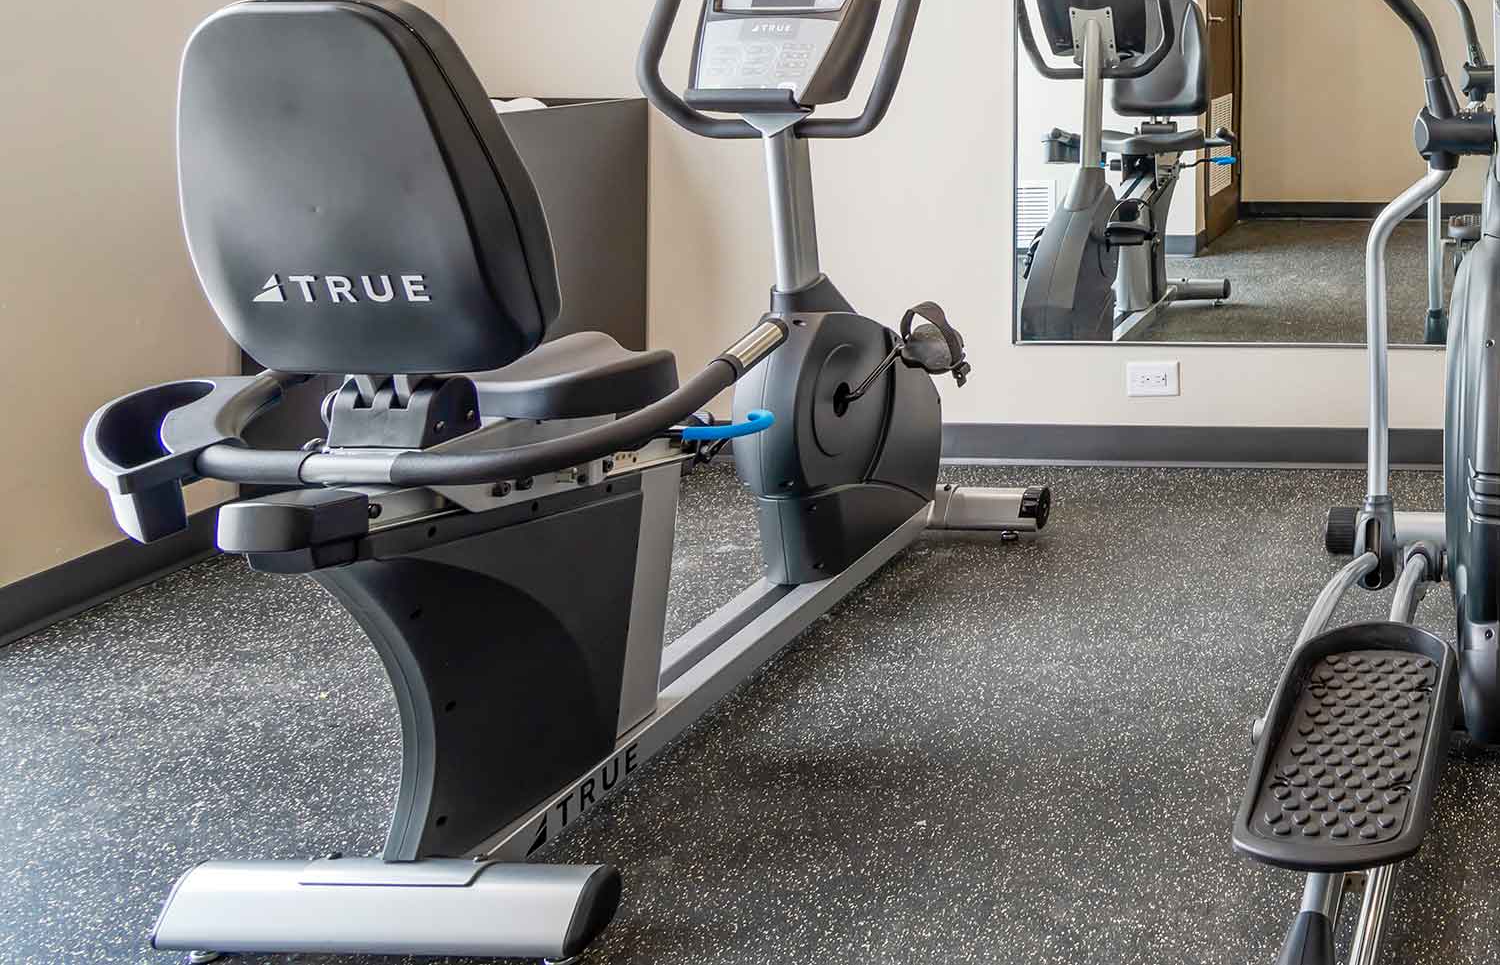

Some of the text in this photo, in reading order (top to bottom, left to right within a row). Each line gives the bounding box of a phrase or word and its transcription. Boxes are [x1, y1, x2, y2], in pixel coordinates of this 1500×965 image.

[760, 23, 792, 32] TRUE
[288, 274, 433, 304] TRUE
[556, 743, 638, 827] TRUE
